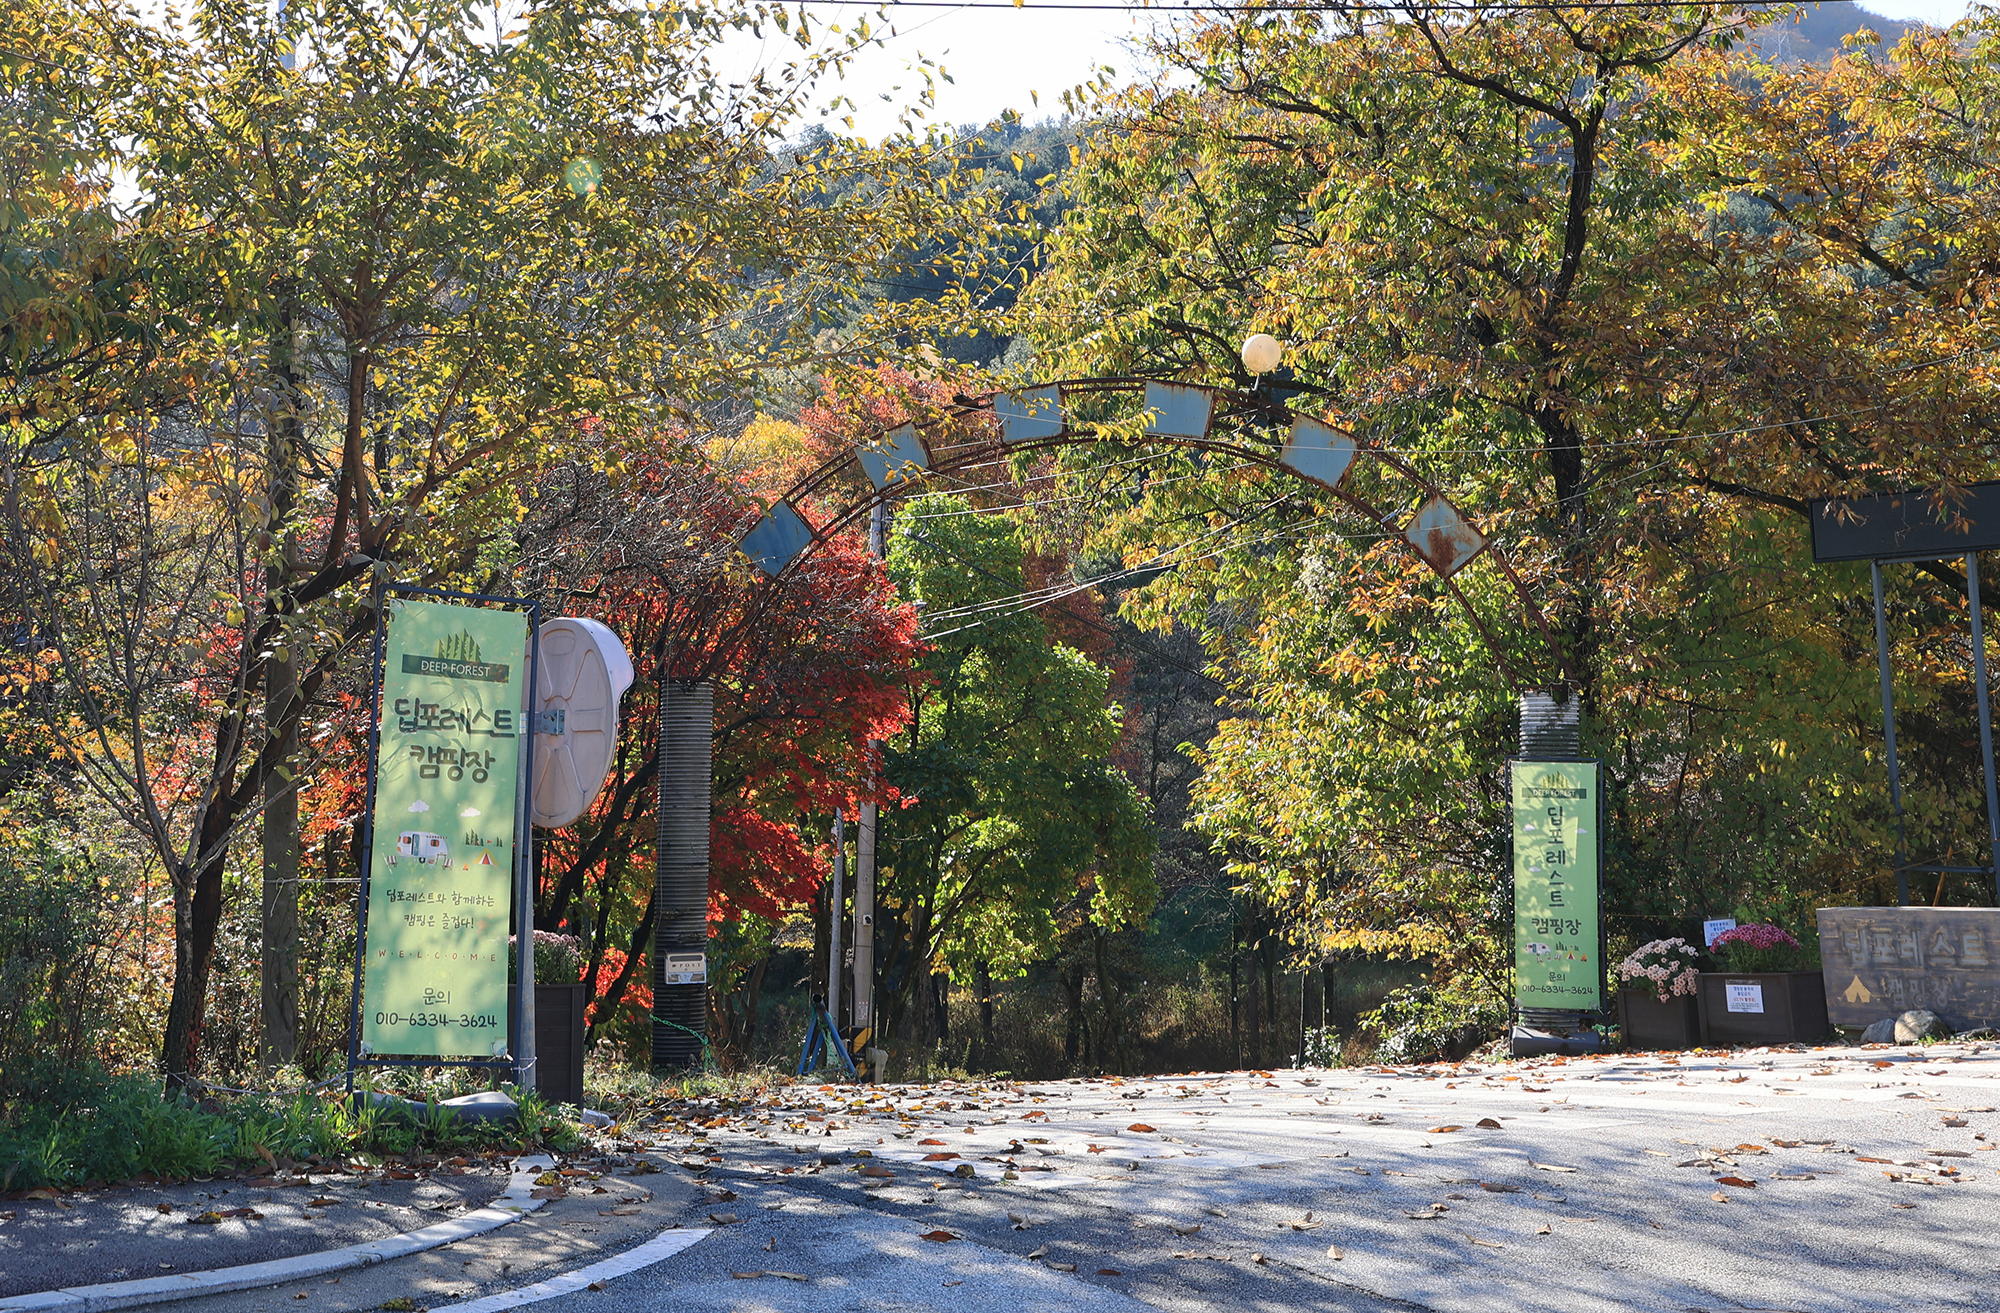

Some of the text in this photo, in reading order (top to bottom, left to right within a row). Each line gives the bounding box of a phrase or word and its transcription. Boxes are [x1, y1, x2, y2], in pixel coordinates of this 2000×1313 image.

[421, 660, 491, 677] DEEP FOREST
[394, 697, 516, 738] 딥포레스트
[410, 745, 496, 783] 캠핑장
[1533, 789, 1576, 797] DEEP FOREST
[386, 888, 495, 907] 딥포레스트와 함께하는
[403, 913, 475, 930] 캠핑은 즐겁다!
[1531, 918, 1582, 936] 캠핑장
[422, 987, 451, 1006] 문의
[1522, 984, 1594, 995] 010-6334-3624
[375, 1012, 497, 1028] 010-6334-3624
